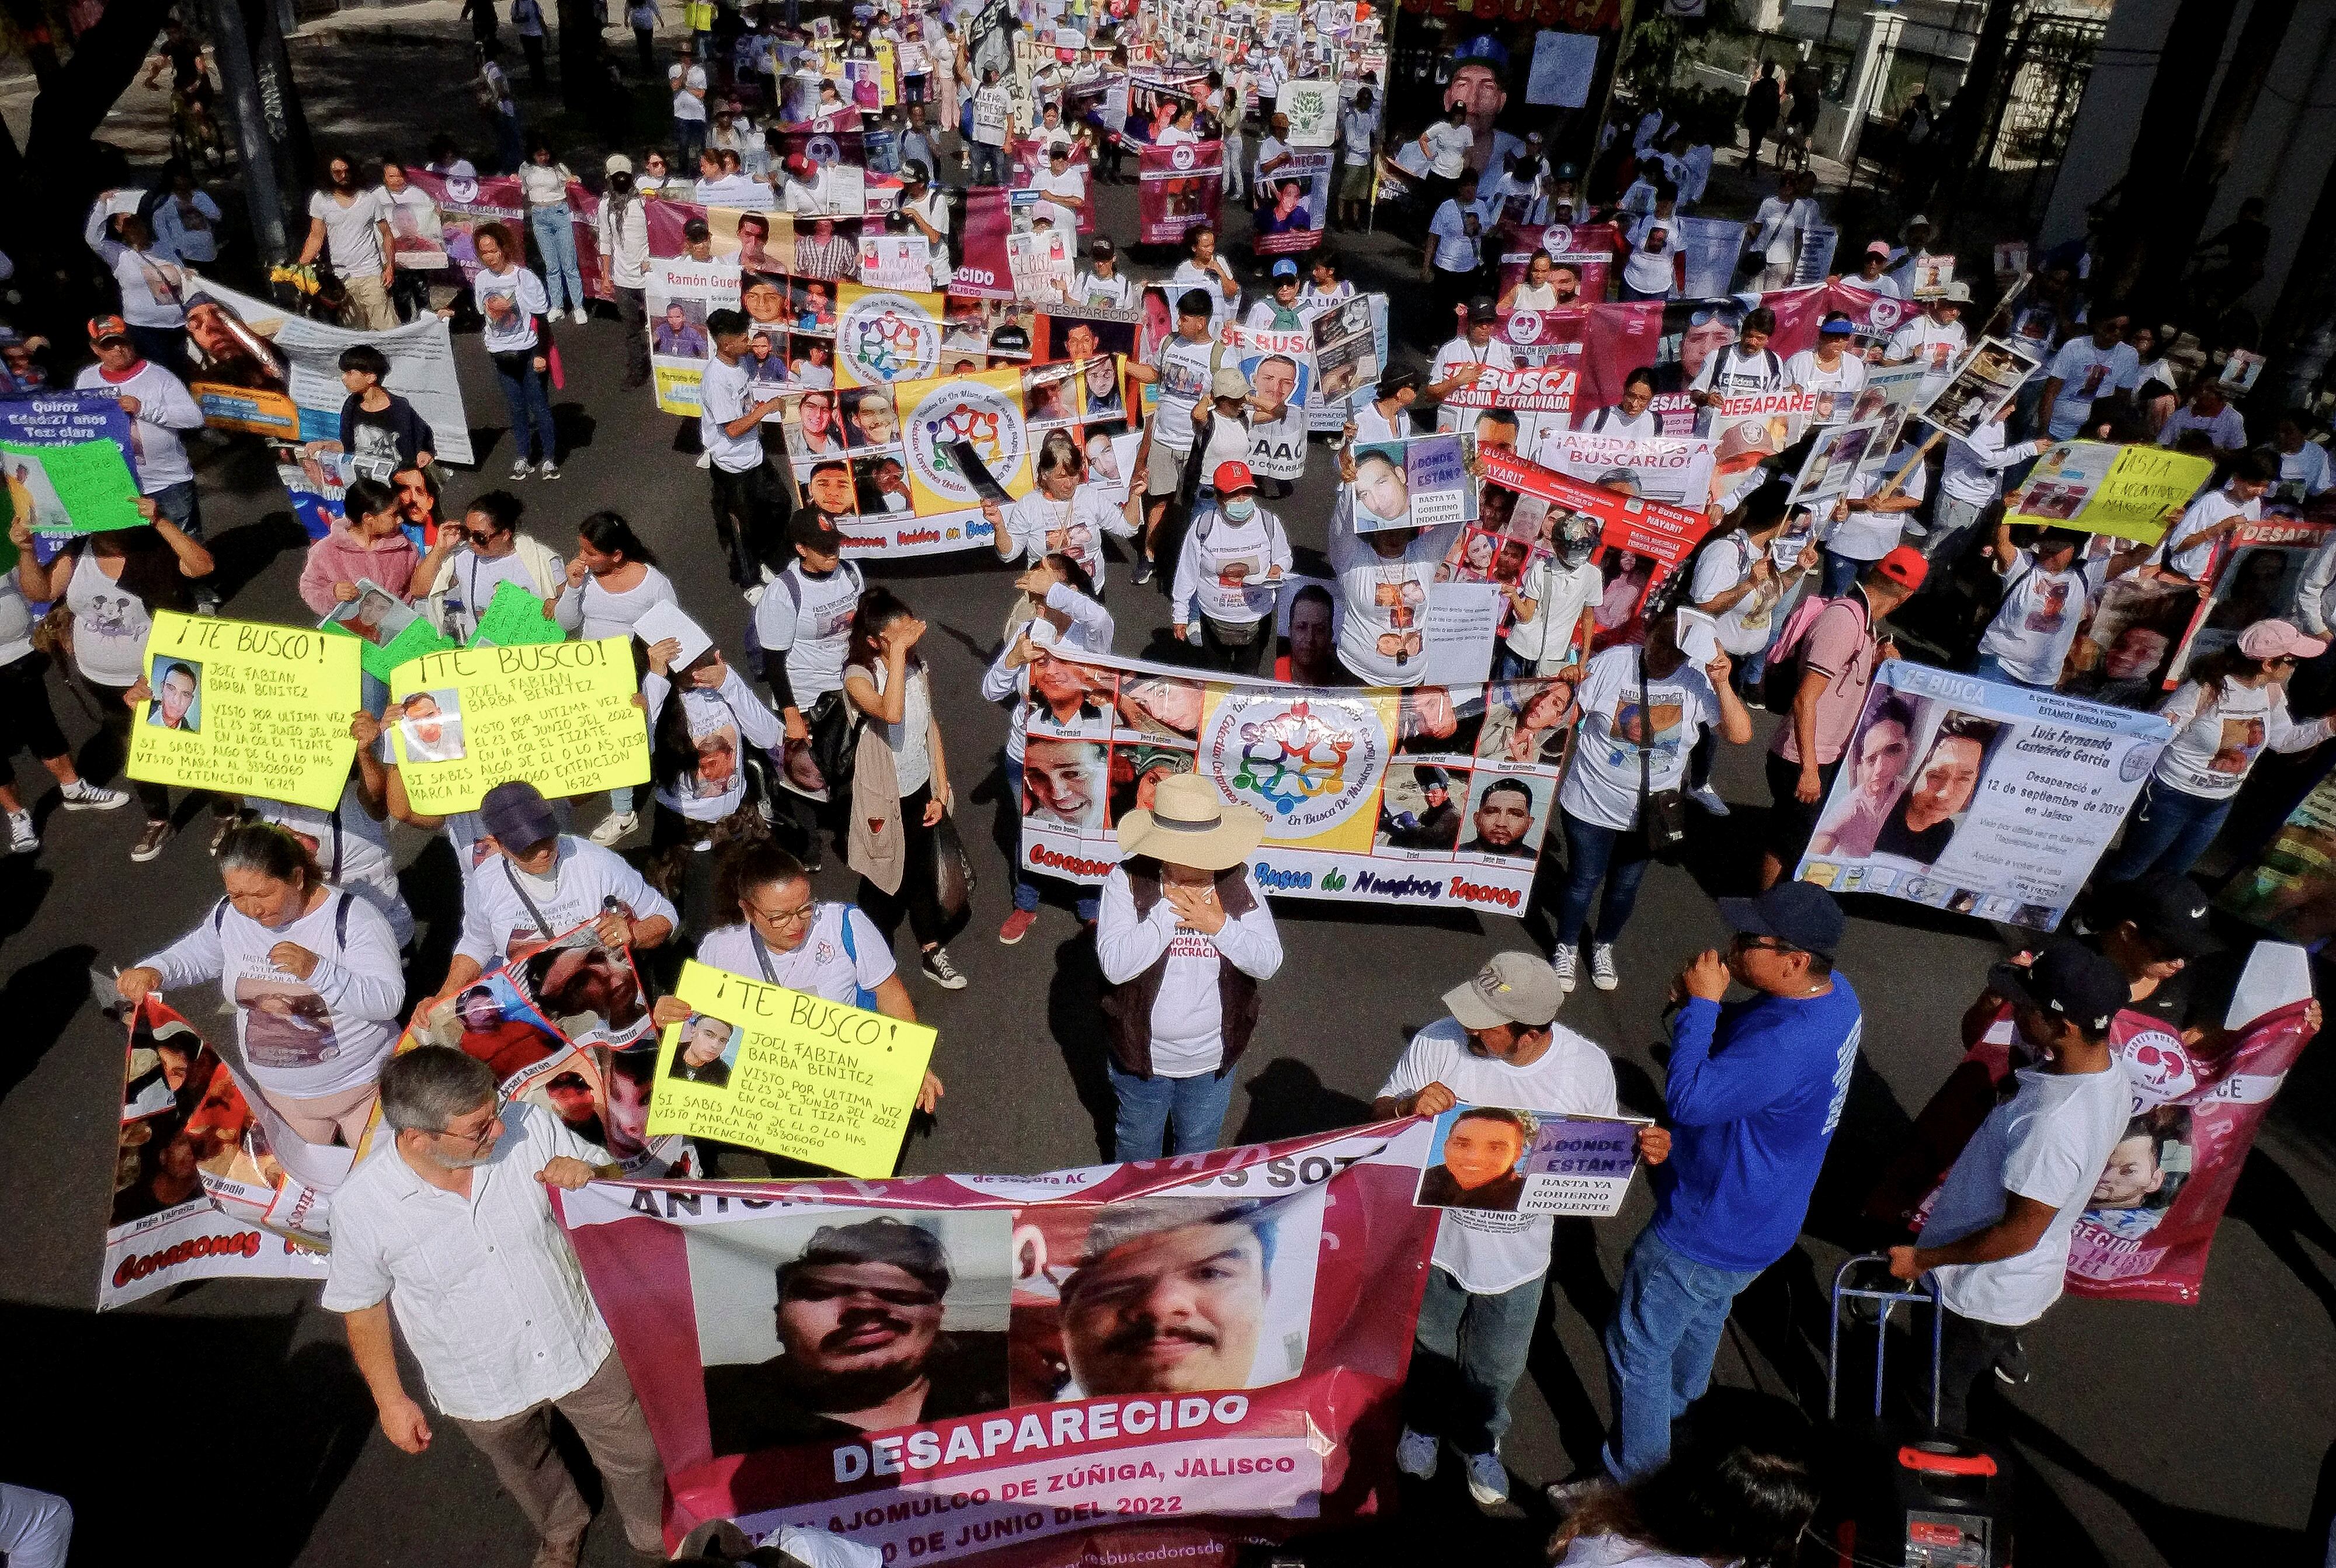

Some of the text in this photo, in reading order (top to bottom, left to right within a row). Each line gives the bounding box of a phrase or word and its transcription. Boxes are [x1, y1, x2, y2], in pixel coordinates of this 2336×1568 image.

[666, 272, 707, 287] Ramón
[1046, 303, 1139, 322] DESAPARECIDO
[1221, 327, 1245, 349] SE
[1477, 368, 1577, 395] BUSCA
[1495, 394, 1570, 409] EXTRAVIADA
[1416, 514, 1460, 524] INDOLENTE
[1417, 504, 1458, 513] GOBIERNO
[498, 641, 607, 674] BUSCO!
[465, 672, 573, 698] JOEL FABIAN
[468, 680, 596, 712] BARBA BENITEZ
[607, 708, 634, 722] 2022
[2031, 724, 2056, 740] Luis
[2057, 729, 2112, 752] Fernando
[1987, 778, 2000, 791] 12
[2003, 783, 2016, 794] de
[2020, 787, 2079, 808] septiembre
[2083, 799, 2097, 812] de
[1303, 807, 1337, 825] Busca
[2025, 806, 2037, 815] en
[1254, 863, 1522, 909] Busca de Nuestros Tesoros
[791, 995, 898, 1052] BUSCO!
[749, 1048, 874, 1086] BARBA BENITEZ
[794, 1043, 858, 1069] FABIAN
[743, 1066, 784, 1085] VISTO
[792, 1080, 815, 1095] POR
[823, 1088, 872, 1108] ULTIMA
[1065, 1173, 1086, 1184] AC
[1541, 1178, 1612, 1189] BASTA YA
[1525, 1201, 1610, 1212] INDOLENTE
[1532, 1191, 1610, 1201] GOBIERNO
[1480, 1212, 1517, 1221] JUNIO
[113, 1231, 261, 1288] Corazones
[833, 1395, 1249, 1483] DESAPARECIDO
[795, 1456, 1295, 1534] AJOMULCO DE ZÚÑIGA, JALISCO
[908, 1532, 946, 1558] DE
[955, 1511, 1045, 1547] JUNIO
[1052, 1501, 1107, 1525] DEL
[1117, 1496, 1183, 1515] 2022
